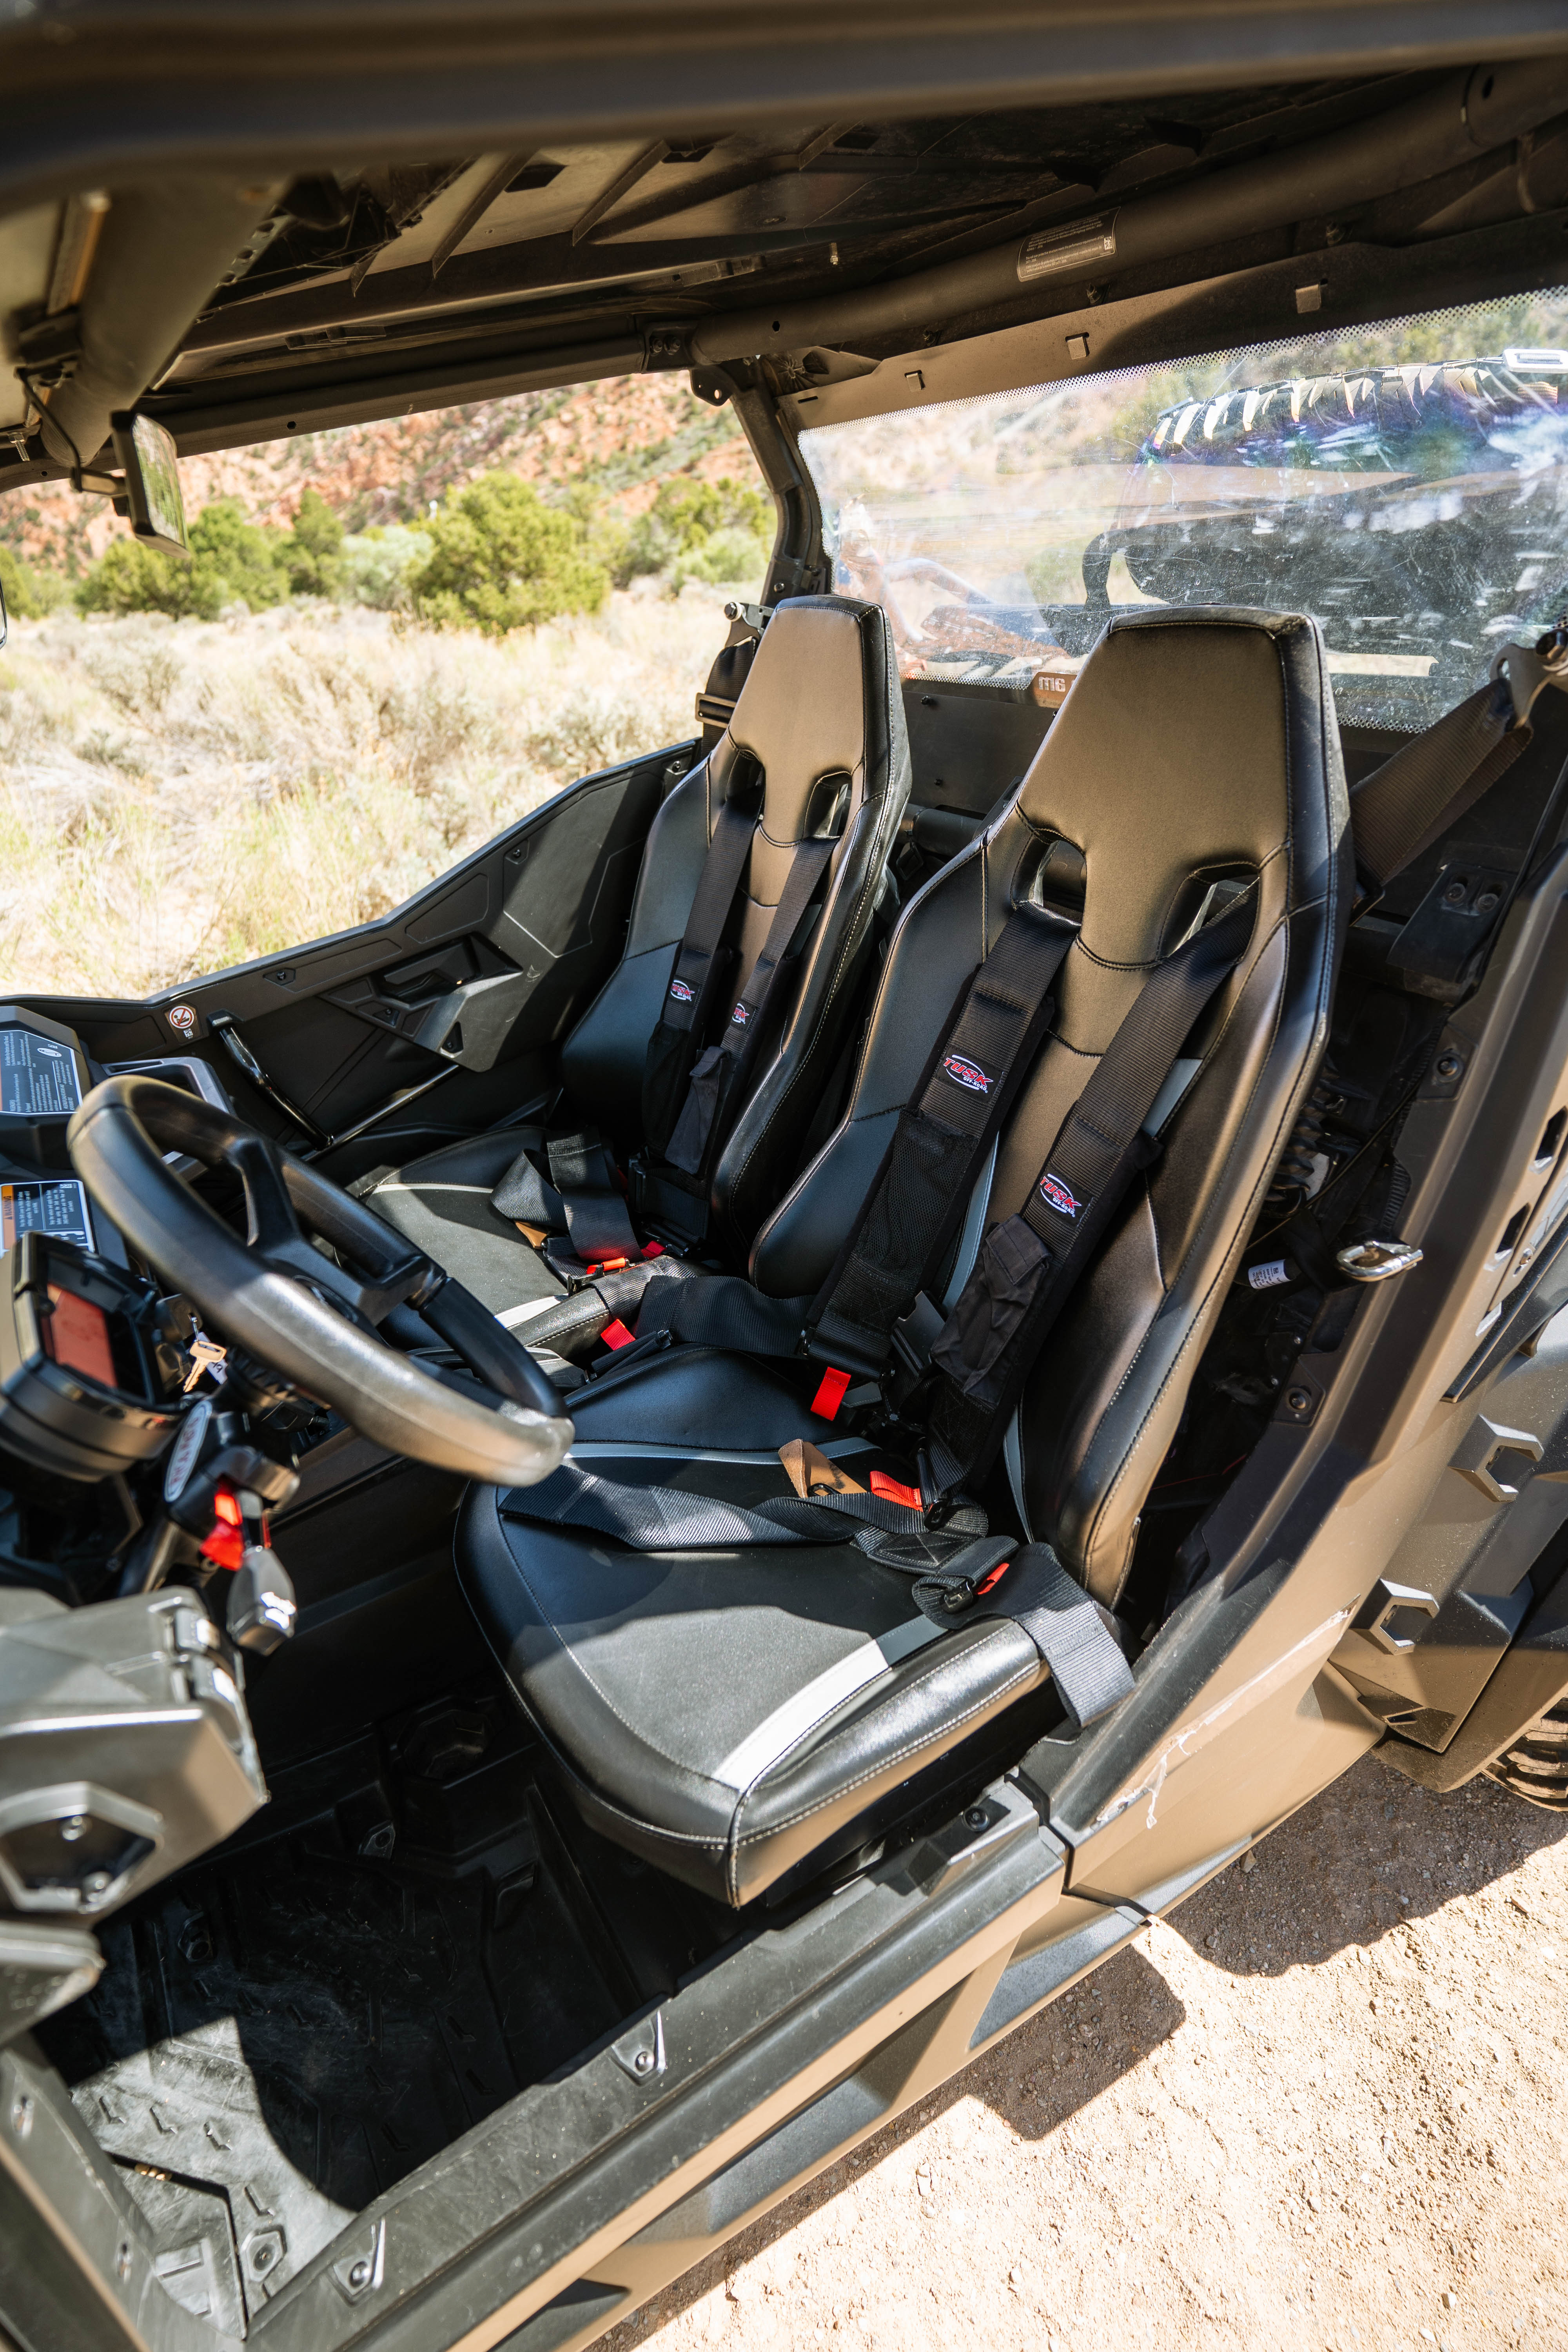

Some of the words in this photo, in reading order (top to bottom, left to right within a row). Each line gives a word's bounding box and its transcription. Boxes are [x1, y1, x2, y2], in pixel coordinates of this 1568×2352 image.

[943, 1058, 993, 1087] TUSK
[963, 1076, 987, 1091] OFF-ROAD
[1040, 1176, 1082, 1211] TUSK
[3, 1196, 13, 1216] WARNING
[1053, 1198, 1074, 1214] OFF-ROAD
